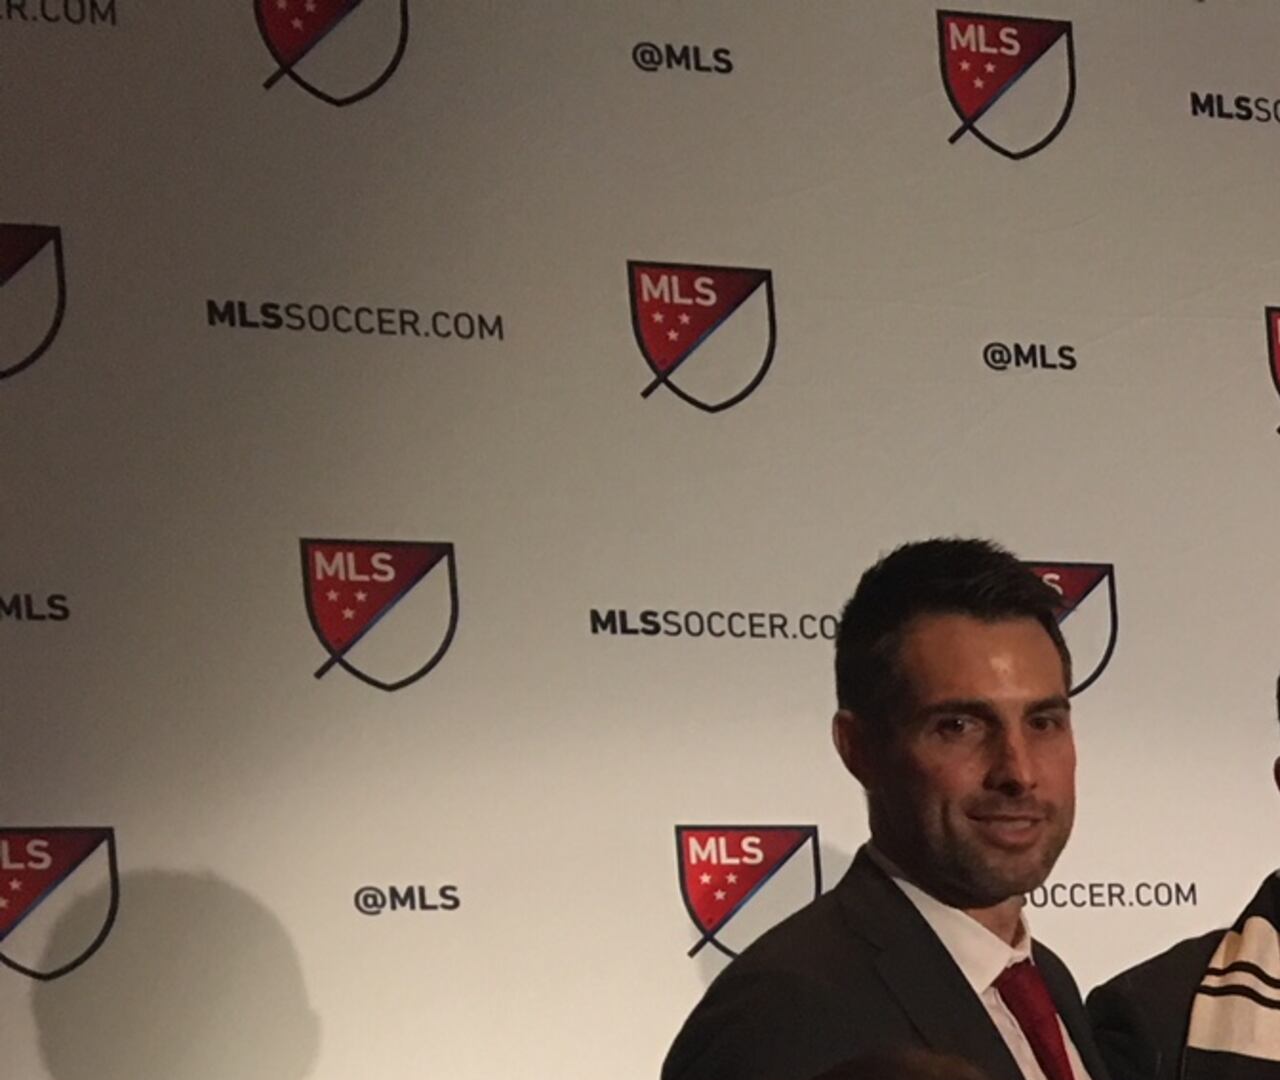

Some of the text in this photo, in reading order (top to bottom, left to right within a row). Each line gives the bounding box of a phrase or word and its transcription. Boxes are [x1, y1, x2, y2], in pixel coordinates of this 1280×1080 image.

[949, 22, 1021, 56] MLS
[631, 41, 734, 75] @MLS
[640, 273, 717, 307] MLS
[205, 298, 504, 340] MLSSOCCER.COM
[982, 342, 1077, 372] @MLS
[315, 551, 396, 582] MLS
[590, 609, 837, 641] MLSSOCCER.CO
[0, 839, 52, 870] LS
[688, 836, 764, 865] MLS
[353, 885, 461, 916] @MLS
[1023, 883, 1196, 907] OCCER.COM
